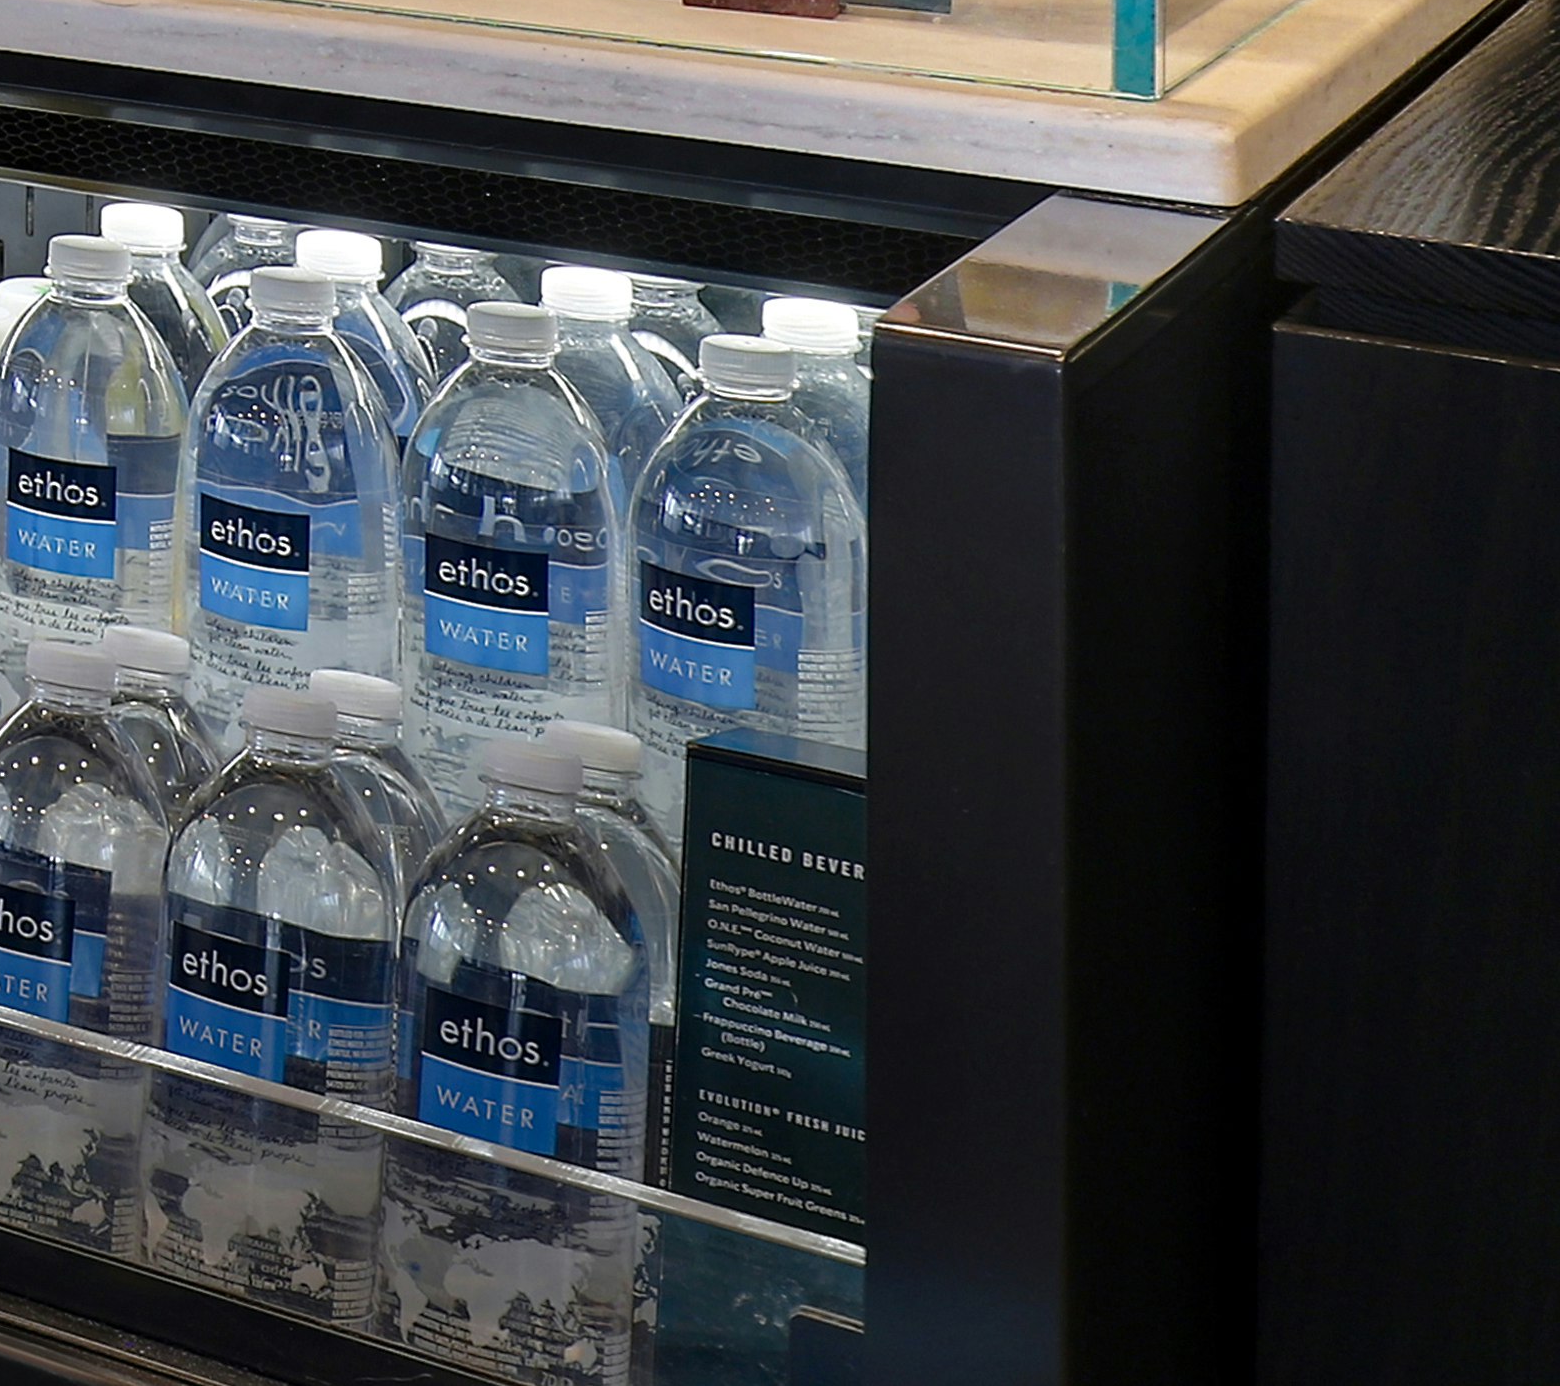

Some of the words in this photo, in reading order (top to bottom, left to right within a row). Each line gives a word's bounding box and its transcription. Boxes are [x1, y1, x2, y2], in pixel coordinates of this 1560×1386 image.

[19, 471, 99, 506] ethos
[17, 528, 96, 559] WATER
[211, 518, 291, 556] ethos
[210, 576, 289, 611] WATER
[439, 557, 530, 596] ethos
[648, 585, 734, 629] ethos
[439, 618, 527, 653] WATER
[648, 649, 732, 687] WATER
[711, 832, 793, 864] CHILLED
[182, 943, 268, 997] ethos
[180, 1015, 262, 1059] WATER
[440, 1015, 538, 1067] ethos
[437, 1086, 535, 1129] WATER
